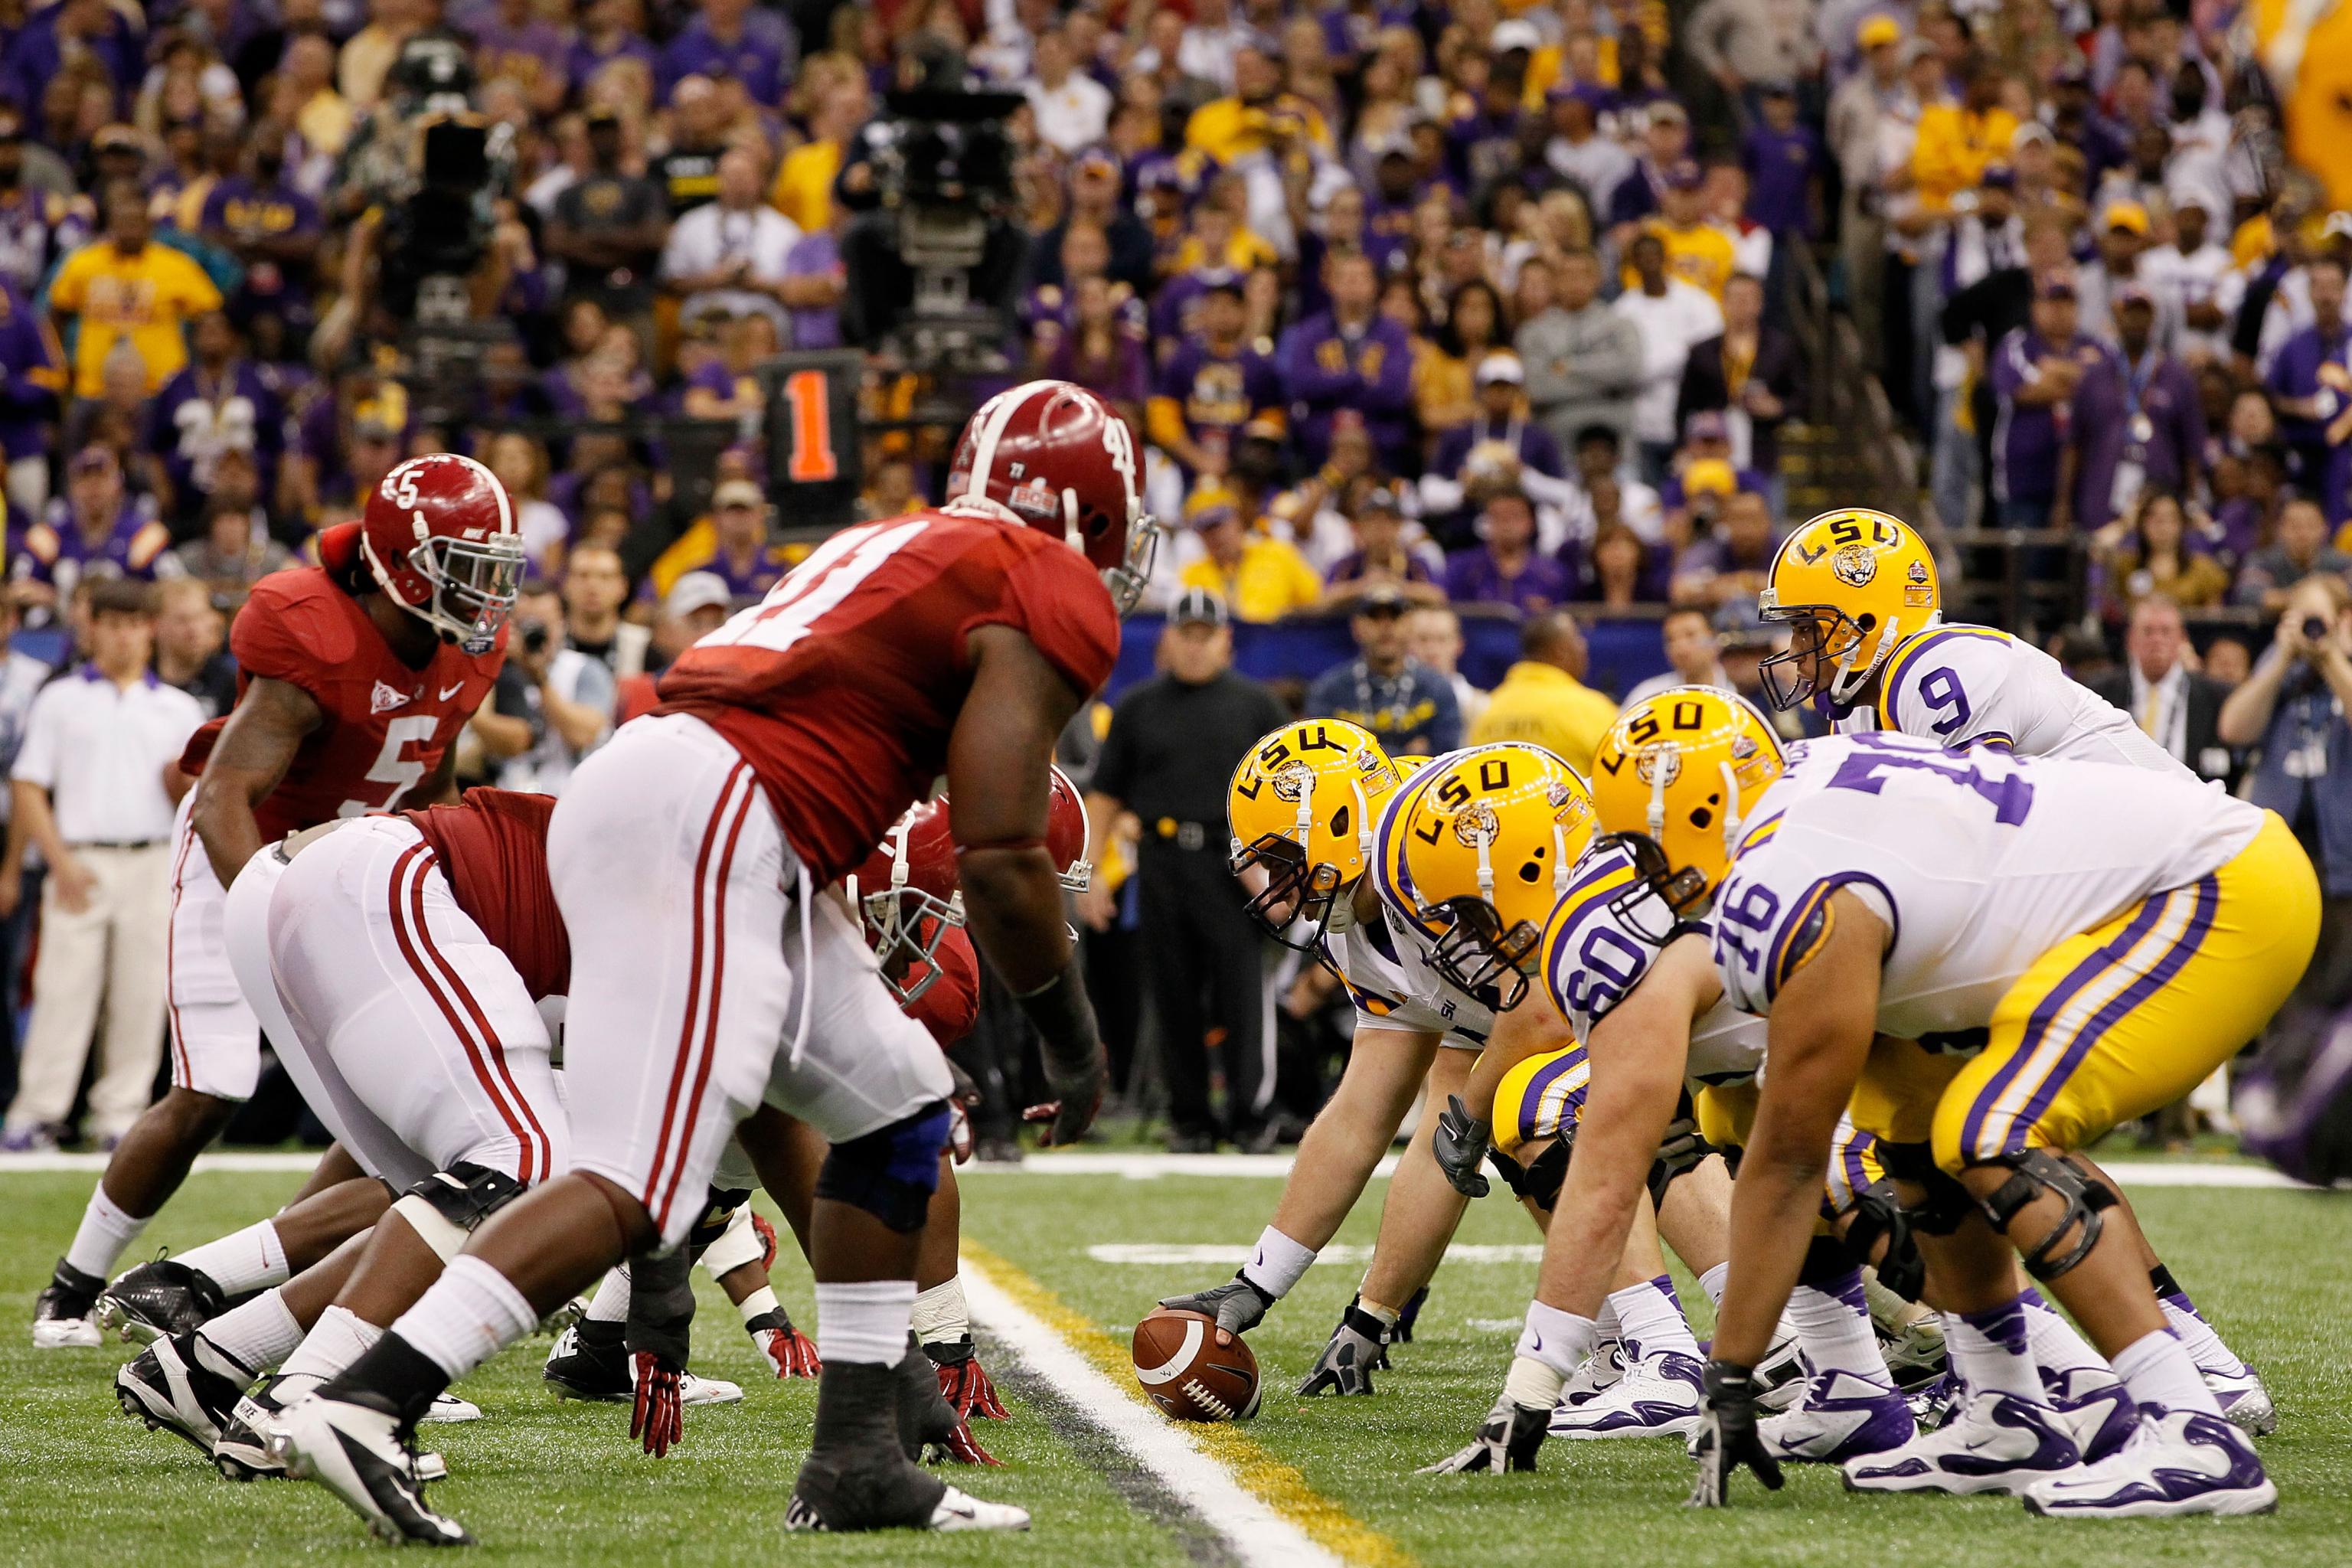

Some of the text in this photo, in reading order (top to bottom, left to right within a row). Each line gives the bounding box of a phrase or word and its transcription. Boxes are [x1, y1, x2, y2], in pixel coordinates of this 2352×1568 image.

[782, 371, 838, 482] 1
[396, 470, 424, 510] 5
[1796, 518, 1898, 565] LSU
[1861, 652, 1885, 681] Riddell
[1919, 666, 1971, 735] 9
[337, 715, 439, 818] 5
[1237, 727, 1327, 802] LSU
[1601, 702, 1704, 776] LSU
[1416, 760, 1510, 846] LSU
[1714, 877, 1781, 975] 76
[1567, 926, 1647, 1028] 60
